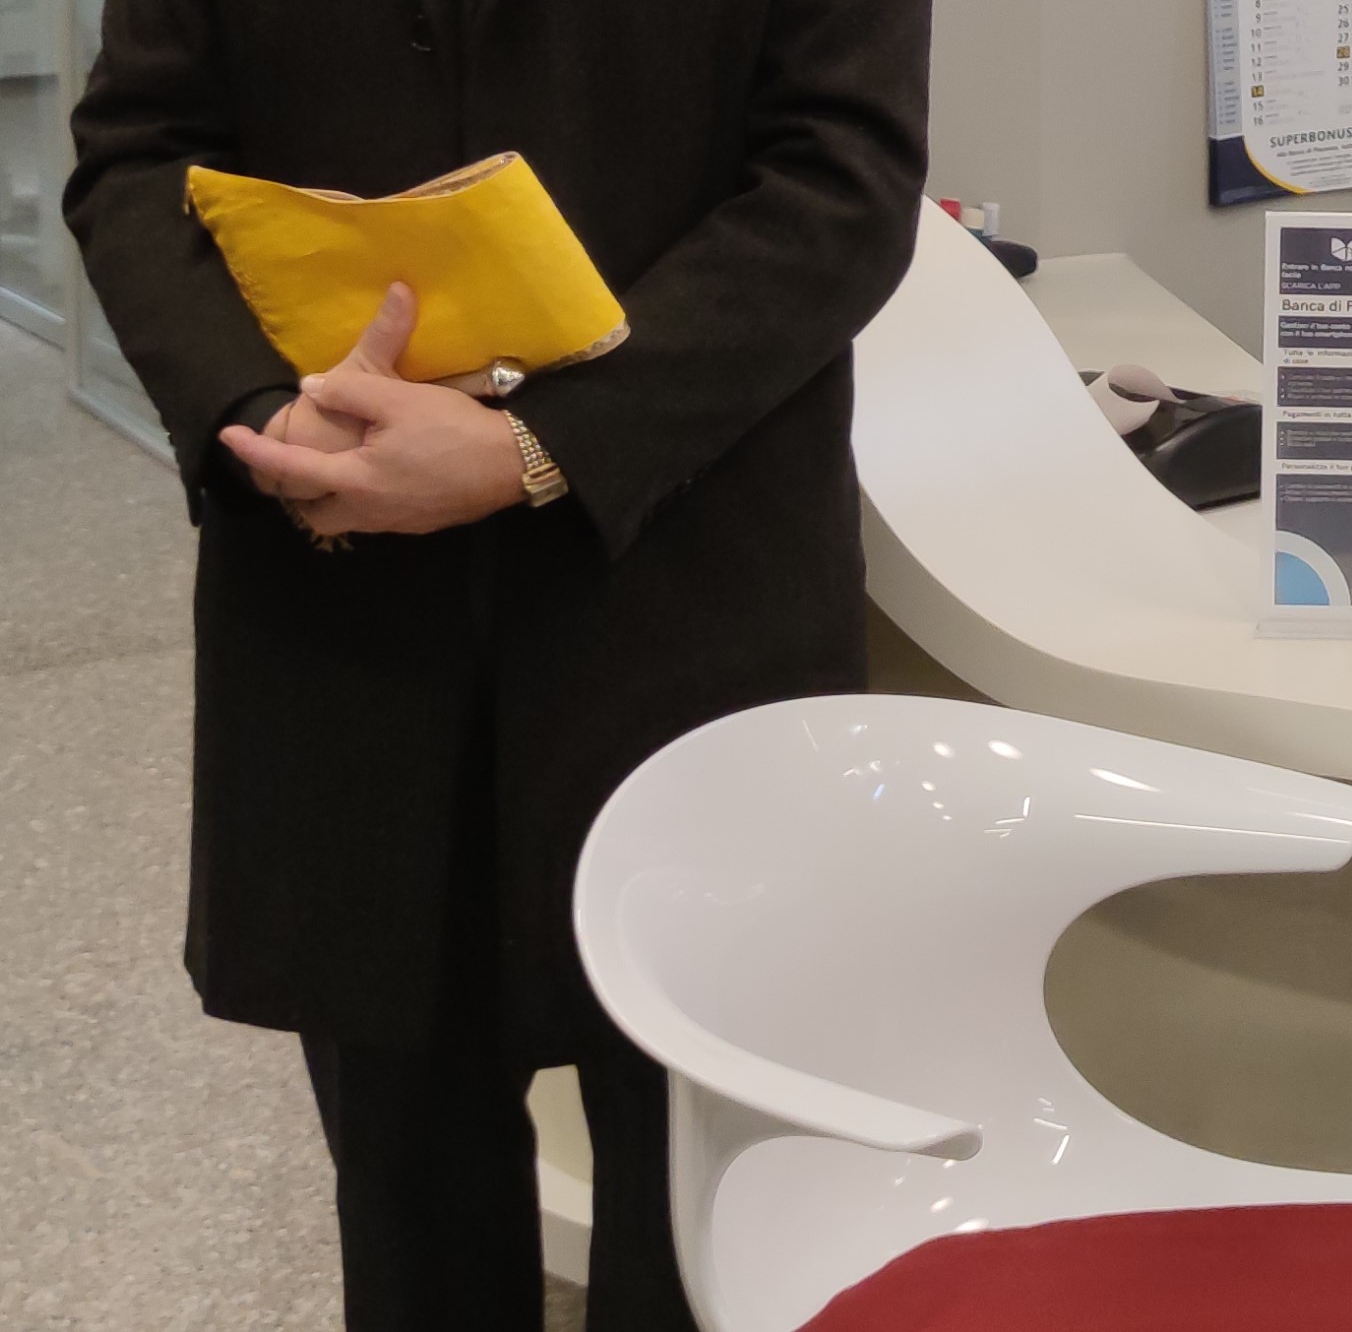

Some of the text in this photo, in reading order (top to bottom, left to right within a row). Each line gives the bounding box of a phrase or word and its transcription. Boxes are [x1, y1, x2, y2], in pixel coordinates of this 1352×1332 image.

[1270, 127, 1352, 149] SUPERBONUS
[1282, 299, 1325, 312] Banca
[1329, 300, 1342, 312] di
